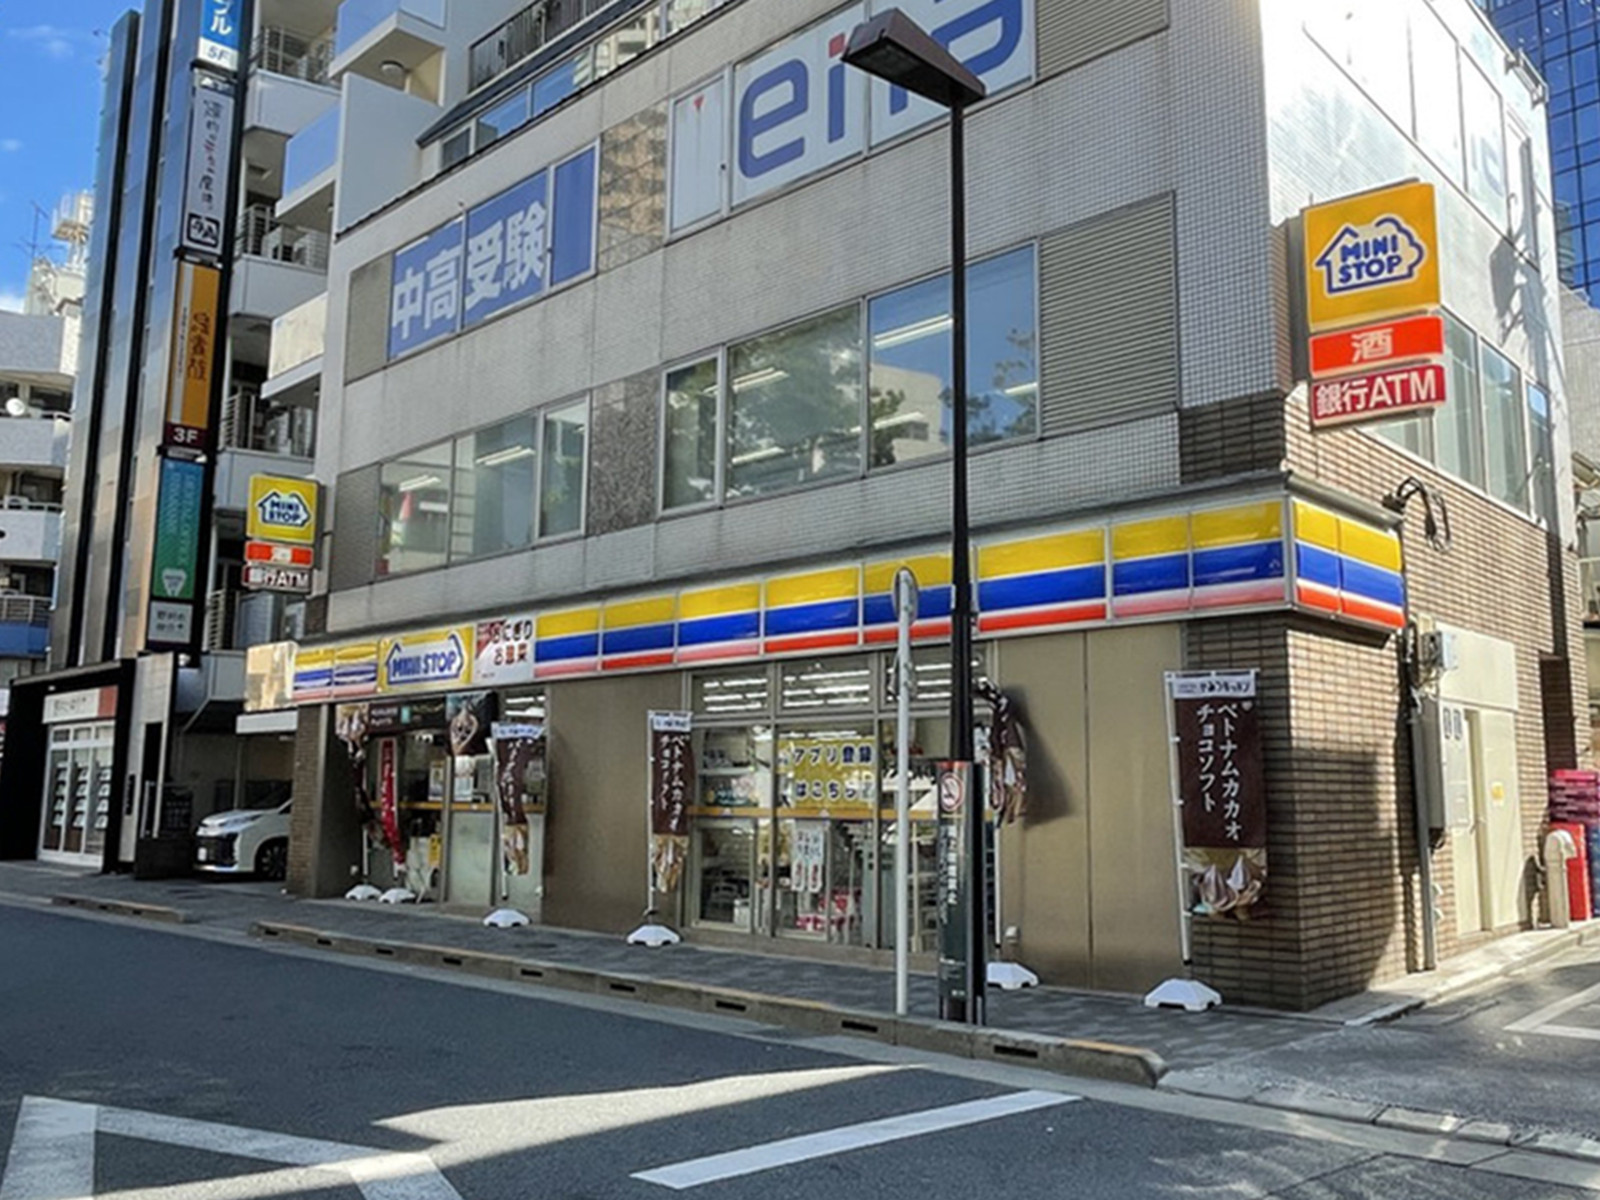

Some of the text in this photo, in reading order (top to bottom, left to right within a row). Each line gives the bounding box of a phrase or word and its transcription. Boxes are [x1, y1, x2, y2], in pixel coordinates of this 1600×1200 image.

[1340, 234, 1399, 263] MINI
[392, 201, 546, 341] 中高受験
[1338, 254, 1403, 285] STOP
[1351, 328, 1394, 363] 酒
[1315, 368, 1437, 417] 銀行ATM
[172, 427, 198, 444] 3F
[269, 510, 300, 522] STOP
[423, 650, 457, 675] STOP
